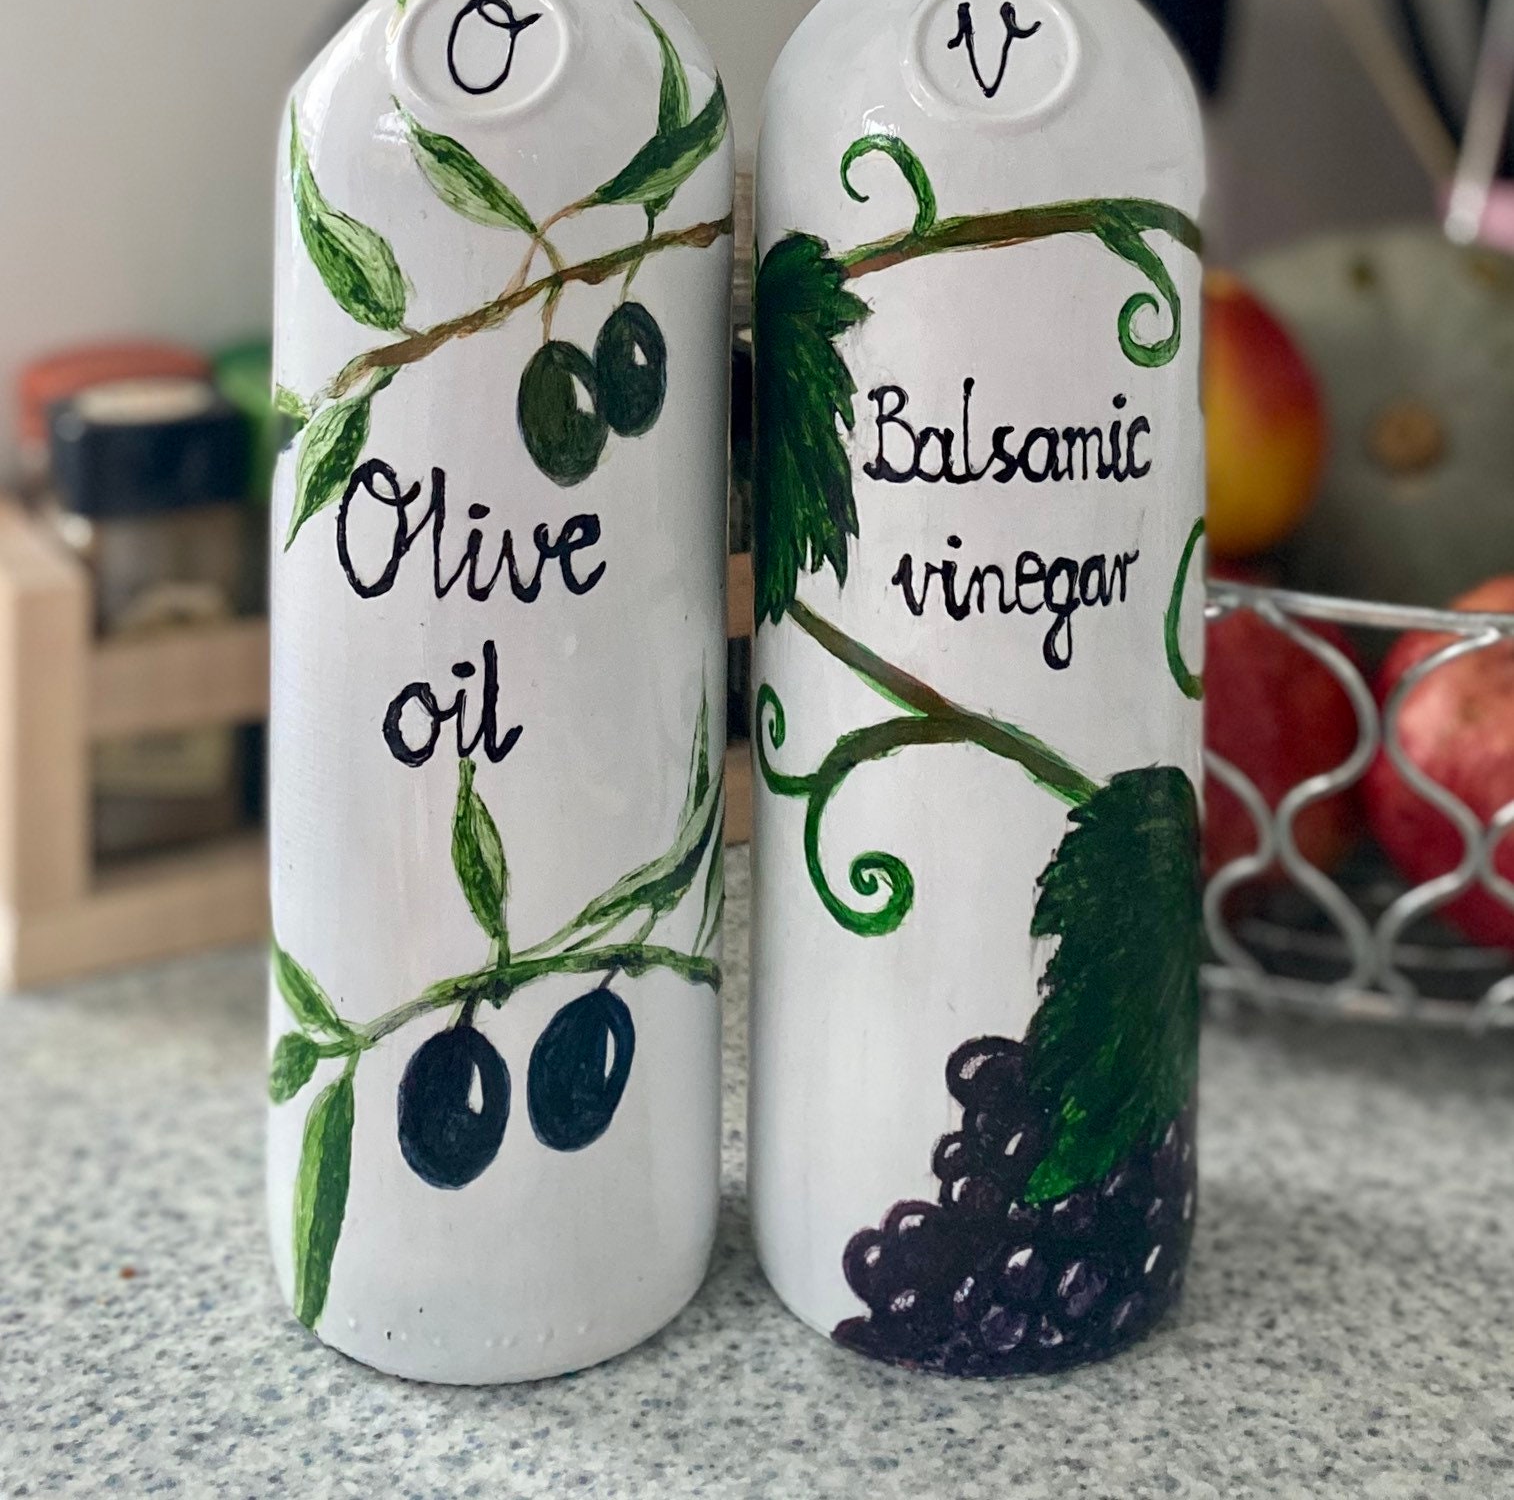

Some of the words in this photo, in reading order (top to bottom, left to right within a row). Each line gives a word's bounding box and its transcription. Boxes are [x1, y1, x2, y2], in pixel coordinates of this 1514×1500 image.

[863, 378, 1152, 484] Balsamic
[336, 458, 607, 602] Olive
[892, 535, 1139, 670] vinegar
[383, 640, 523, 766] oil
